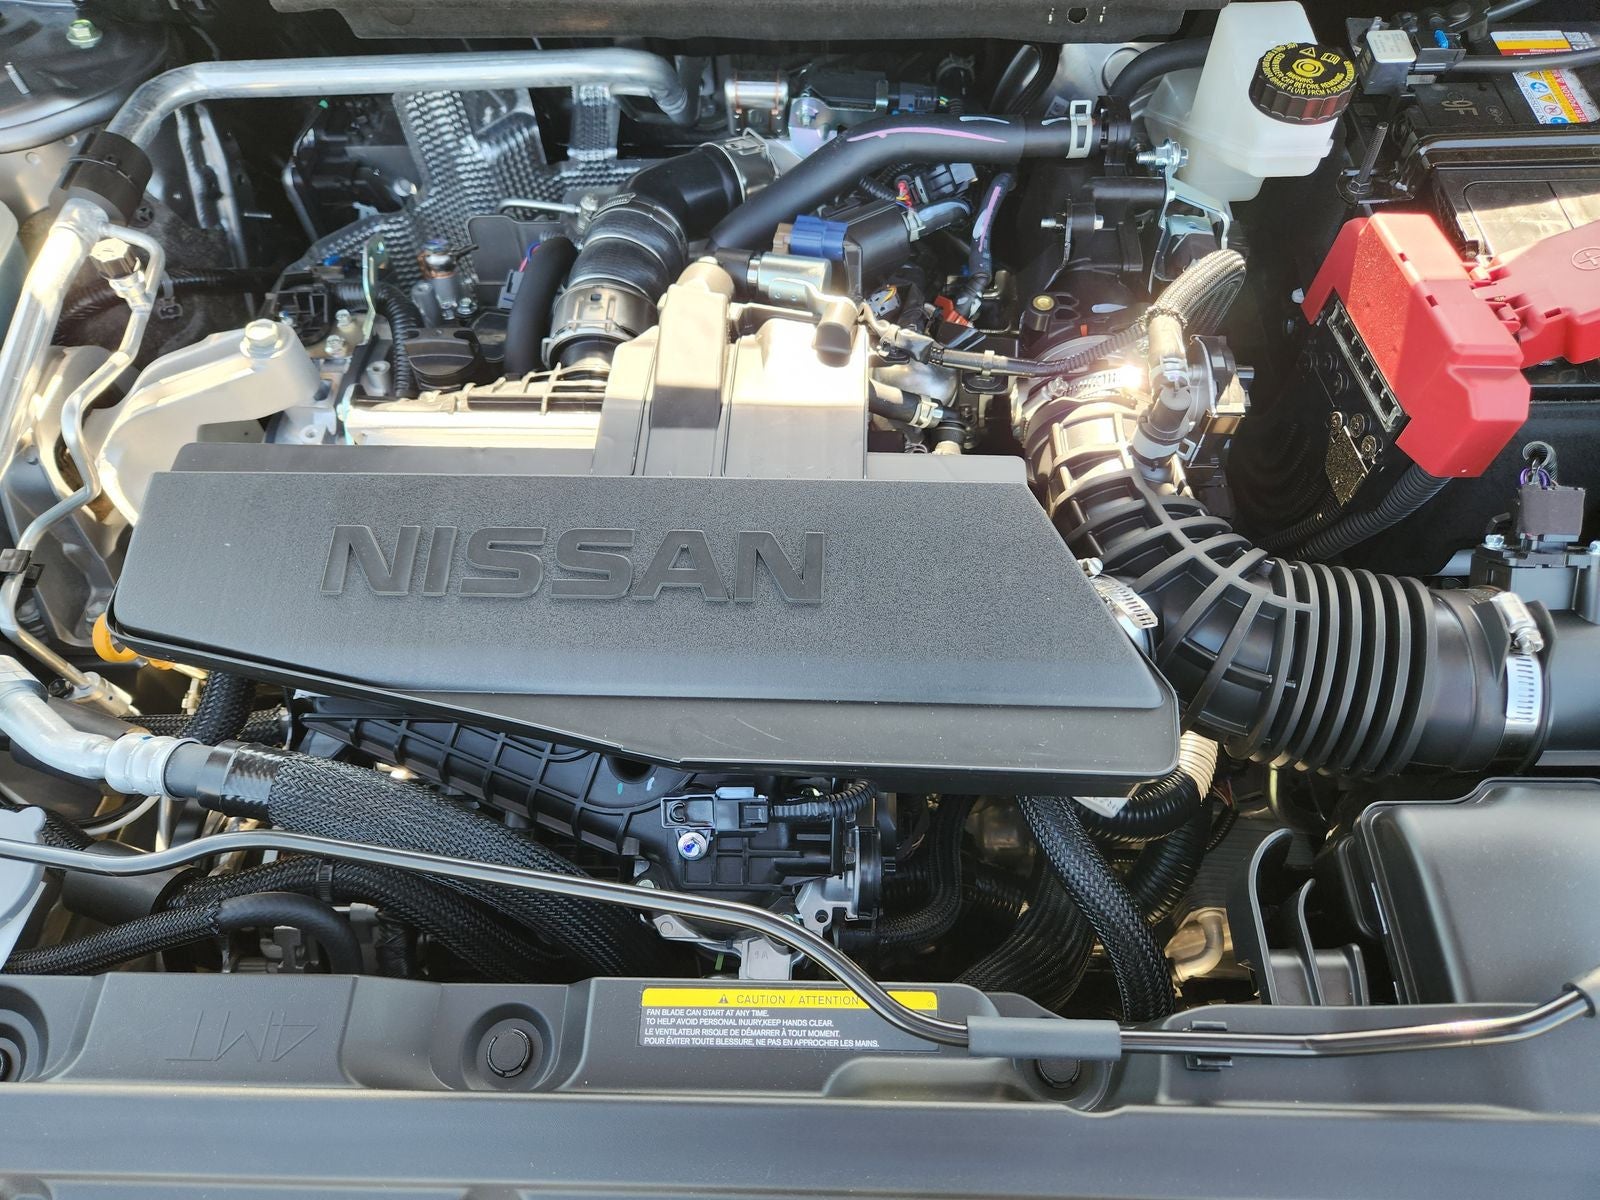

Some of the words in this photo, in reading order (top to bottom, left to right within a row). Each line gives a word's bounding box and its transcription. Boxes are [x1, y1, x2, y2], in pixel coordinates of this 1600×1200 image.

[1281, 76, 1294, 85] CAP
[1294, 80, 1320, 91] BEFORE
[1287, 85, 1306, 95] FLUID
[319, 525, 825, 602] NISSAN
[737, 995, 786, 1004] CAUTION
[798, 995, 859, 1005] ATTENTION
[751, 1009, 769, 1017] TIME.
[700, 1018, 737, 1026] PERSONAL
[808, 1019, 834, 1027] CLEAR.
[654, 1028, 701, 1036] VENTILATEUR
[741, 1027, 780, 1037] DÉMARRER
[781, 1027, 787, 1037] À
[788, 1029, 807, 1037] TOUT
[808, 1030, 840, 1038] MOMENT.
[644, 1037, 665, 1045] POUR
[666, 1036, 690, 1045] ÉVITER
[715, 1038, 755, 1046] BLESSURE,
[756, 1038, 766, 1046] NE
[767, 1038, 782, 1046] PAS
[793, 1039, 839, 1047] APPROCHER
[854, 1040, 880, 1048] MAINS.
